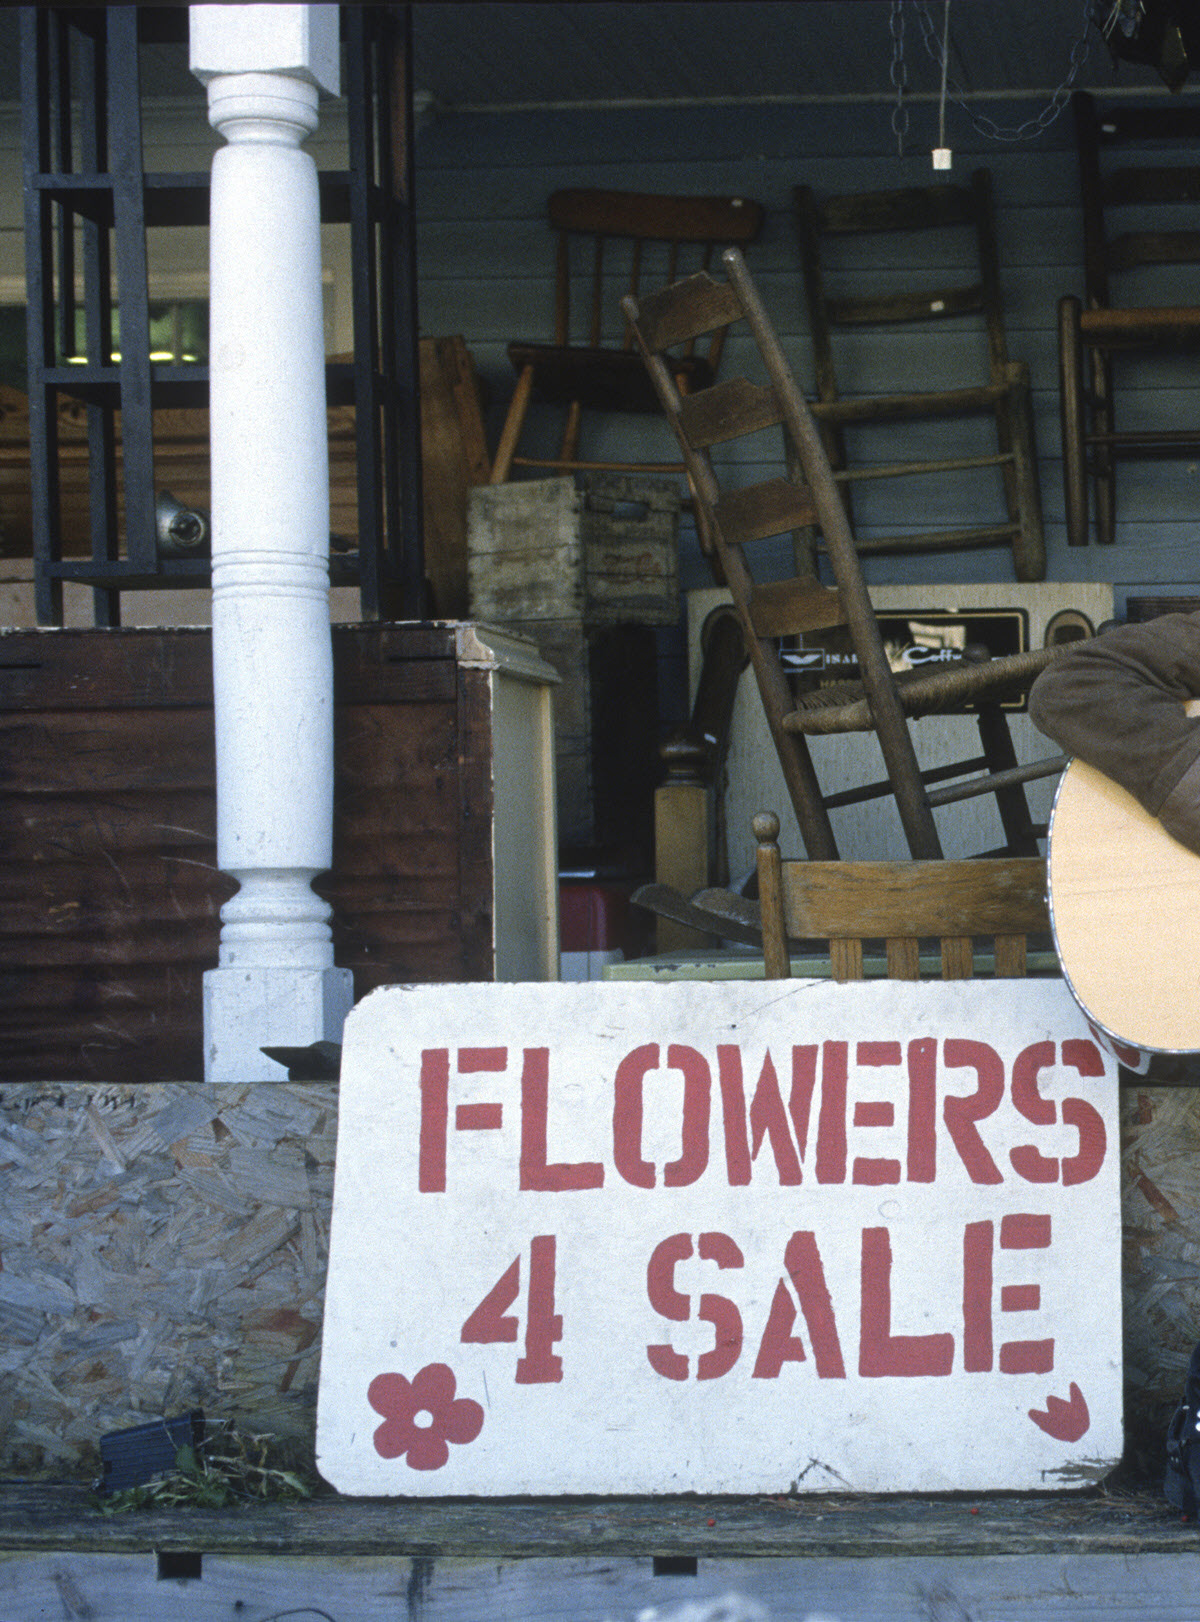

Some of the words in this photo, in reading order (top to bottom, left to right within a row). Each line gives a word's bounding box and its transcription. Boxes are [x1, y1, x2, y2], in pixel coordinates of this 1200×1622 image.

[418, 1037, 1107, 1193] FLOWERS
[460, 1234, 563, 1384] 4
[646, 1213, 1055, 1381] SALE
